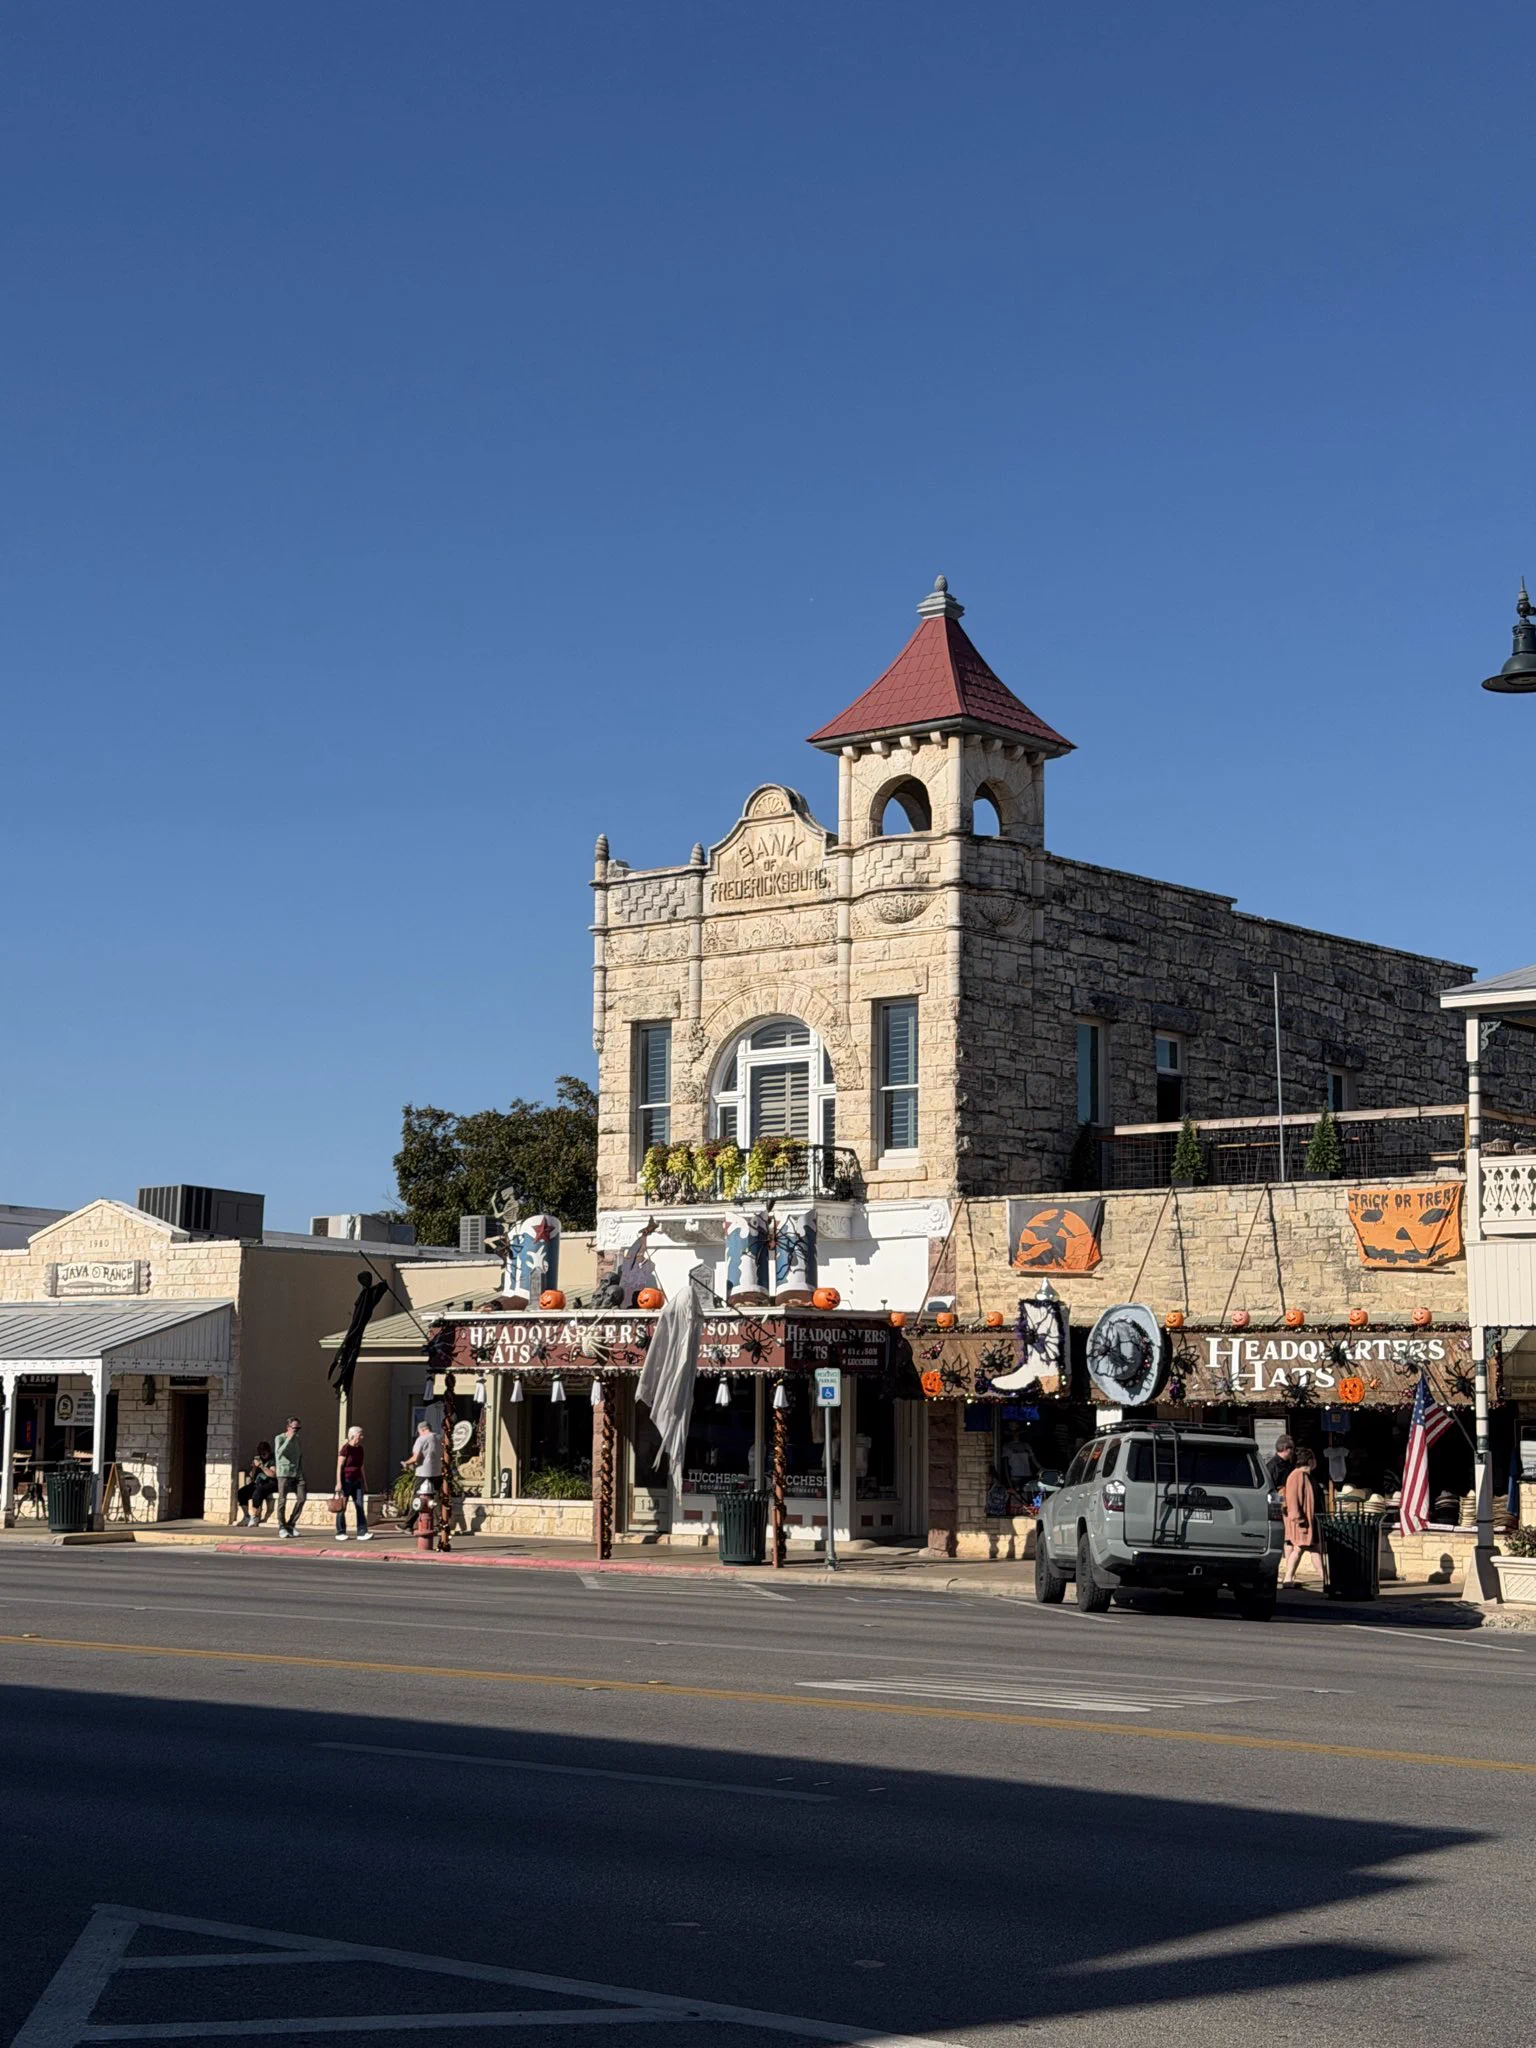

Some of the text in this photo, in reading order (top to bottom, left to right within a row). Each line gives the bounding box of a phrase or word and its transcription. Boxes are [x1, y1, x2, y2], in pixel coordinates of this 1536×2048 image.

[739, 833, 806, 868] BANK
[763, 858, 777, 872] OF
[1352, 1186, 1459, 1209] TRICK OR TREAT
[61, 1265, 133, 1282] JAVA RANCH
[469, 1325, 647, 1345] HEADQUARERS
[477, 1345, 532, 1363] ATS
[792, 1341, 828, 1359] HTS
[1231, 1361, 1335, 1391] HATS
[499, 1472, 509, 1498] OP
